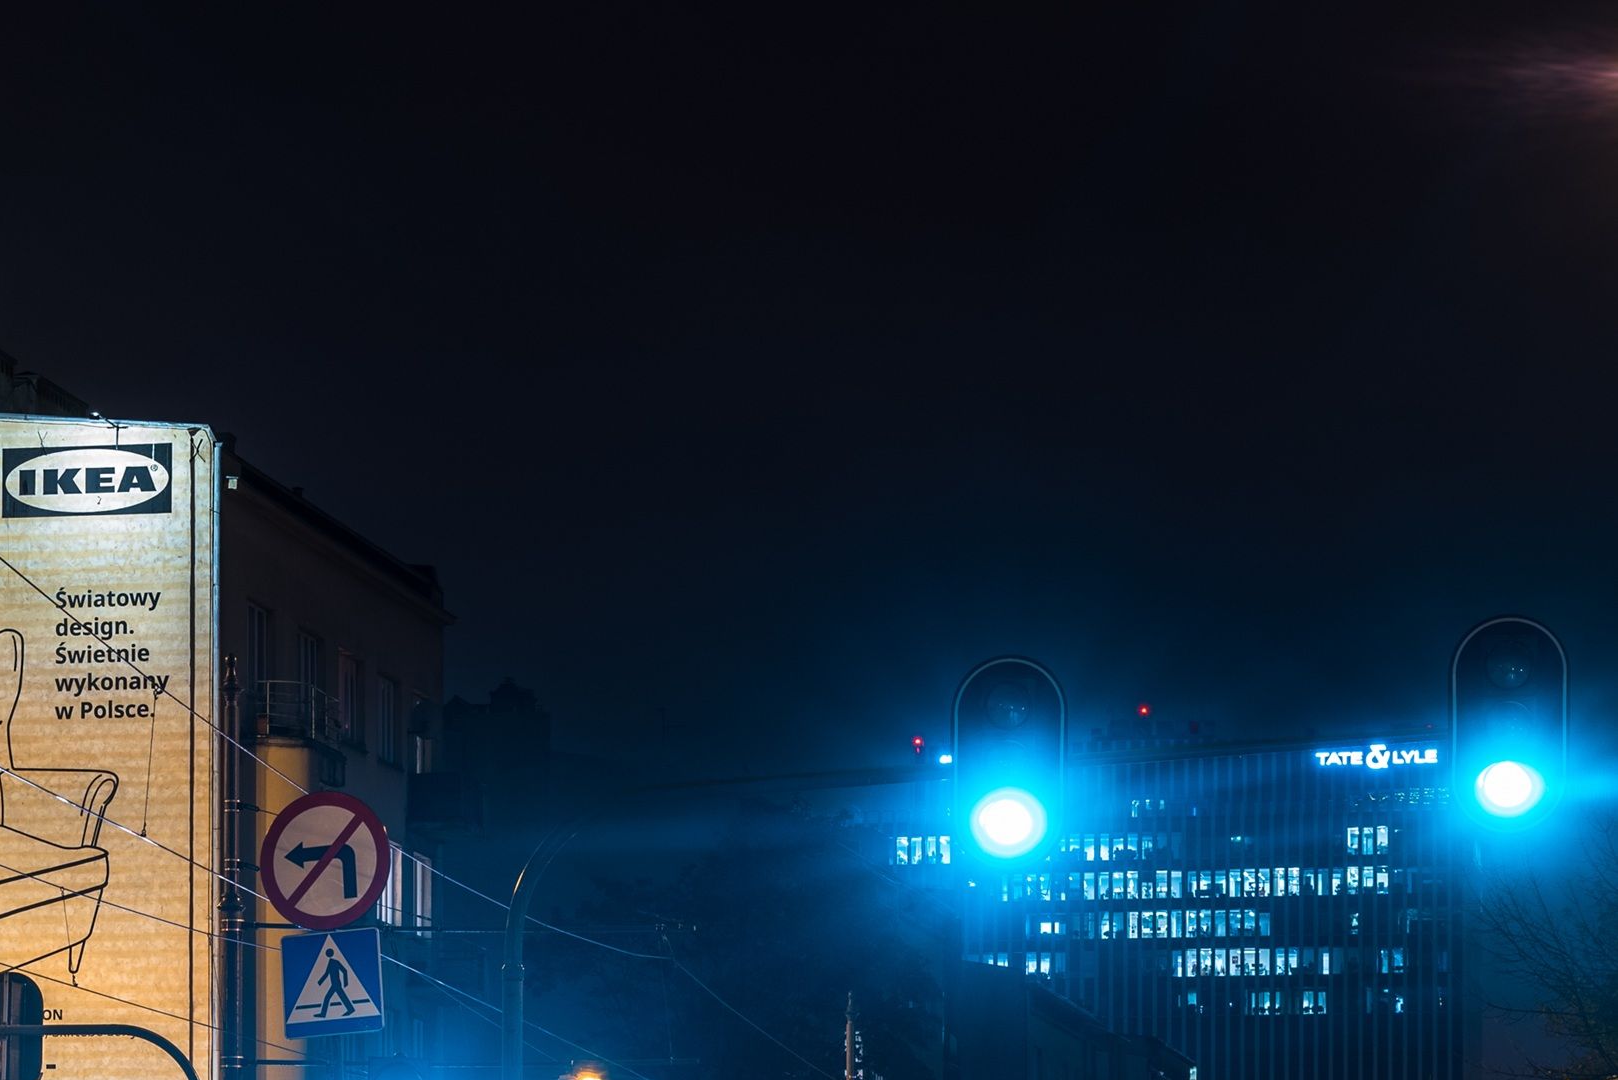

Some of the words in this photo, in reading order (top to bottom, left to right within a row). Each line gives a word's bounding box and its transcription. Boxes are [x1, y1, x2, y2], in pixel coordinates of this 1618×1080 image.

[19, 465, 157, 496] IKEA
[55, 587, 162, 611] Światowy
[55, 617, 135, 640] design.
[55, 642, 150, 664] Świetnie
[54, 672, 170, 697] wykonany
[54, 705, 74, 720] w
[80, 700, 155, 719] Polsce.
[1315, 751, 1364, 766] TATE
[1365, 744, 1391, 769] &
[1392, 749, 1438, 764] LYLE
